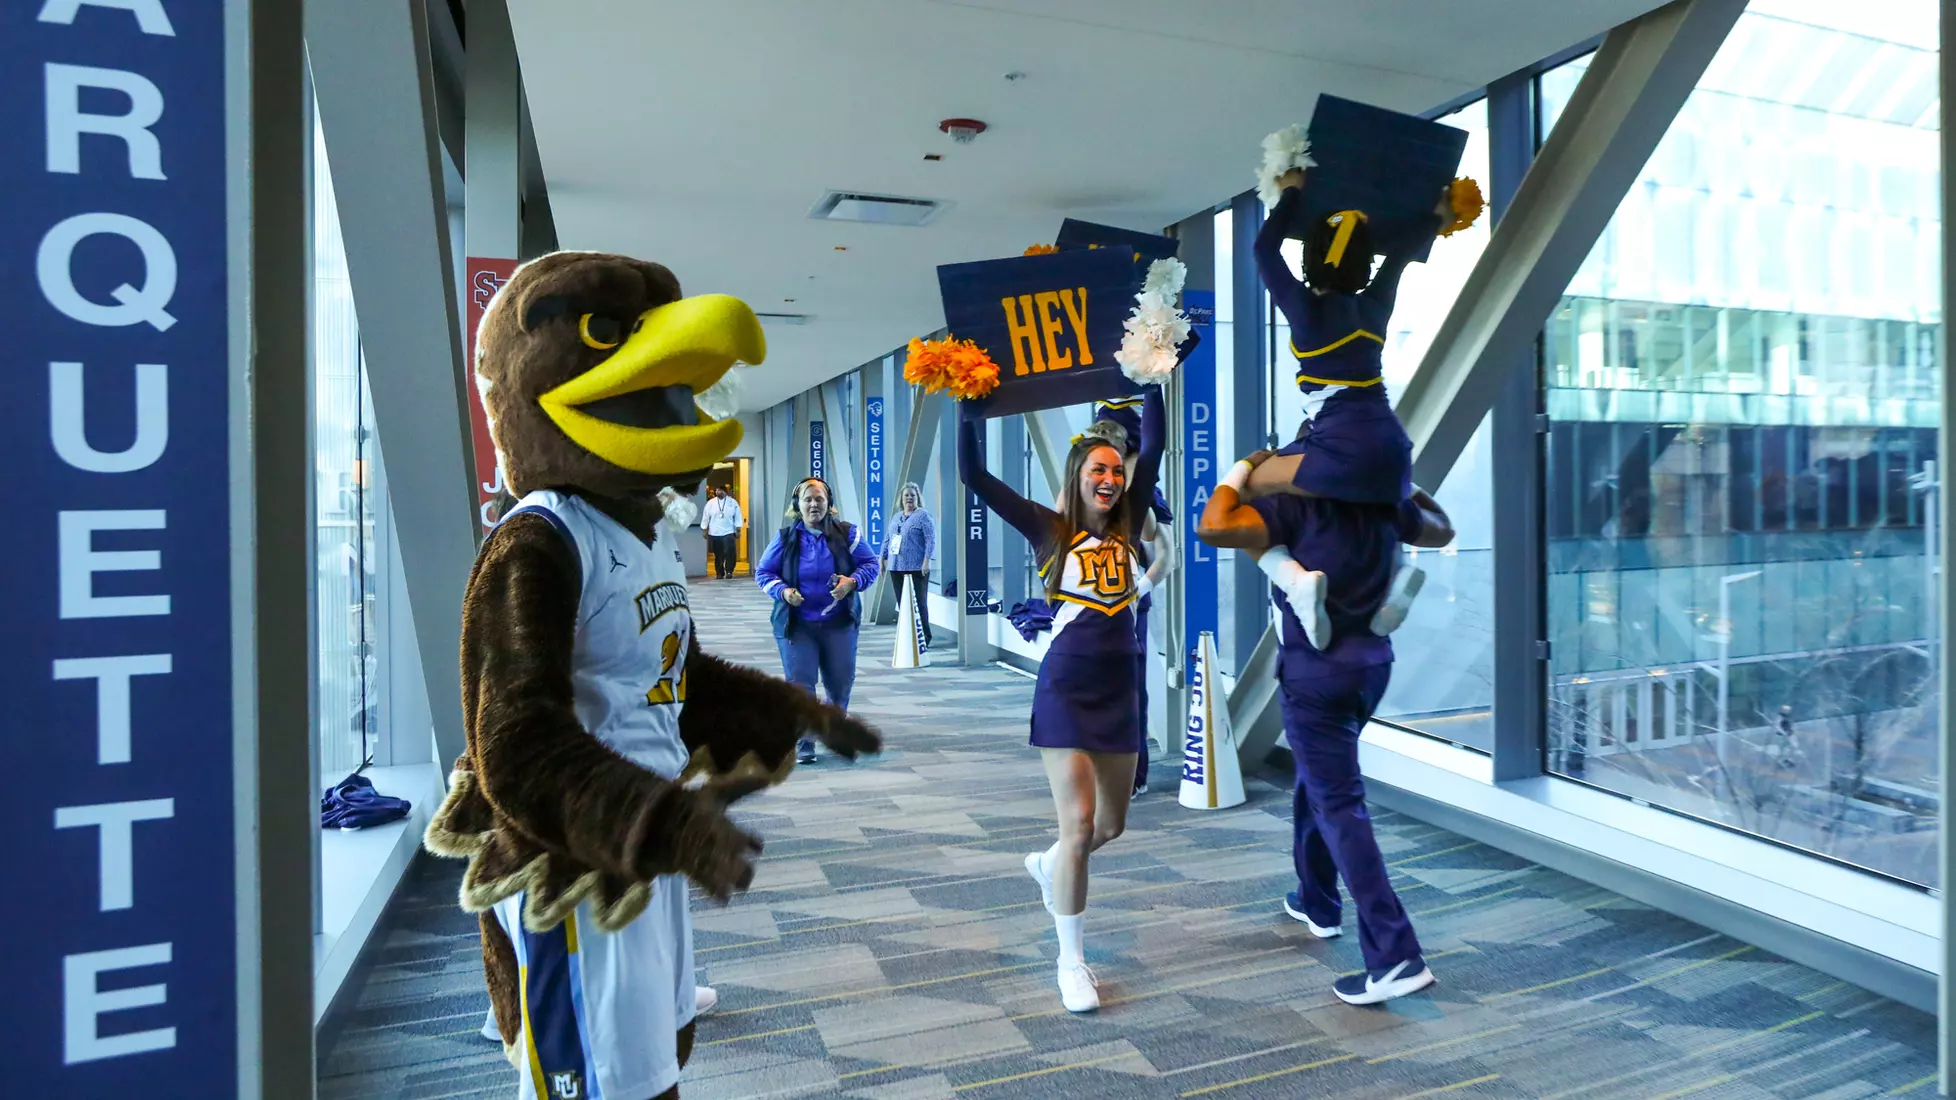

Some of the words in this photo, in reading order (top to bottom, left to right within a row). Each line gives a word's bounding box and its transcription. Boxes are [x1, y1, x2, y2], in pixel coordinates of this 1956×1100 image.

[1001, 286, 1094, 376] HEY
[870, 422, 881, 483] SETON
[871, 497, 881, 545] HALL
[1071, 546, 1129, 598] MU
[1182, 714, 1204, 785] RING
[550, 1070, 581, 1100] MU
